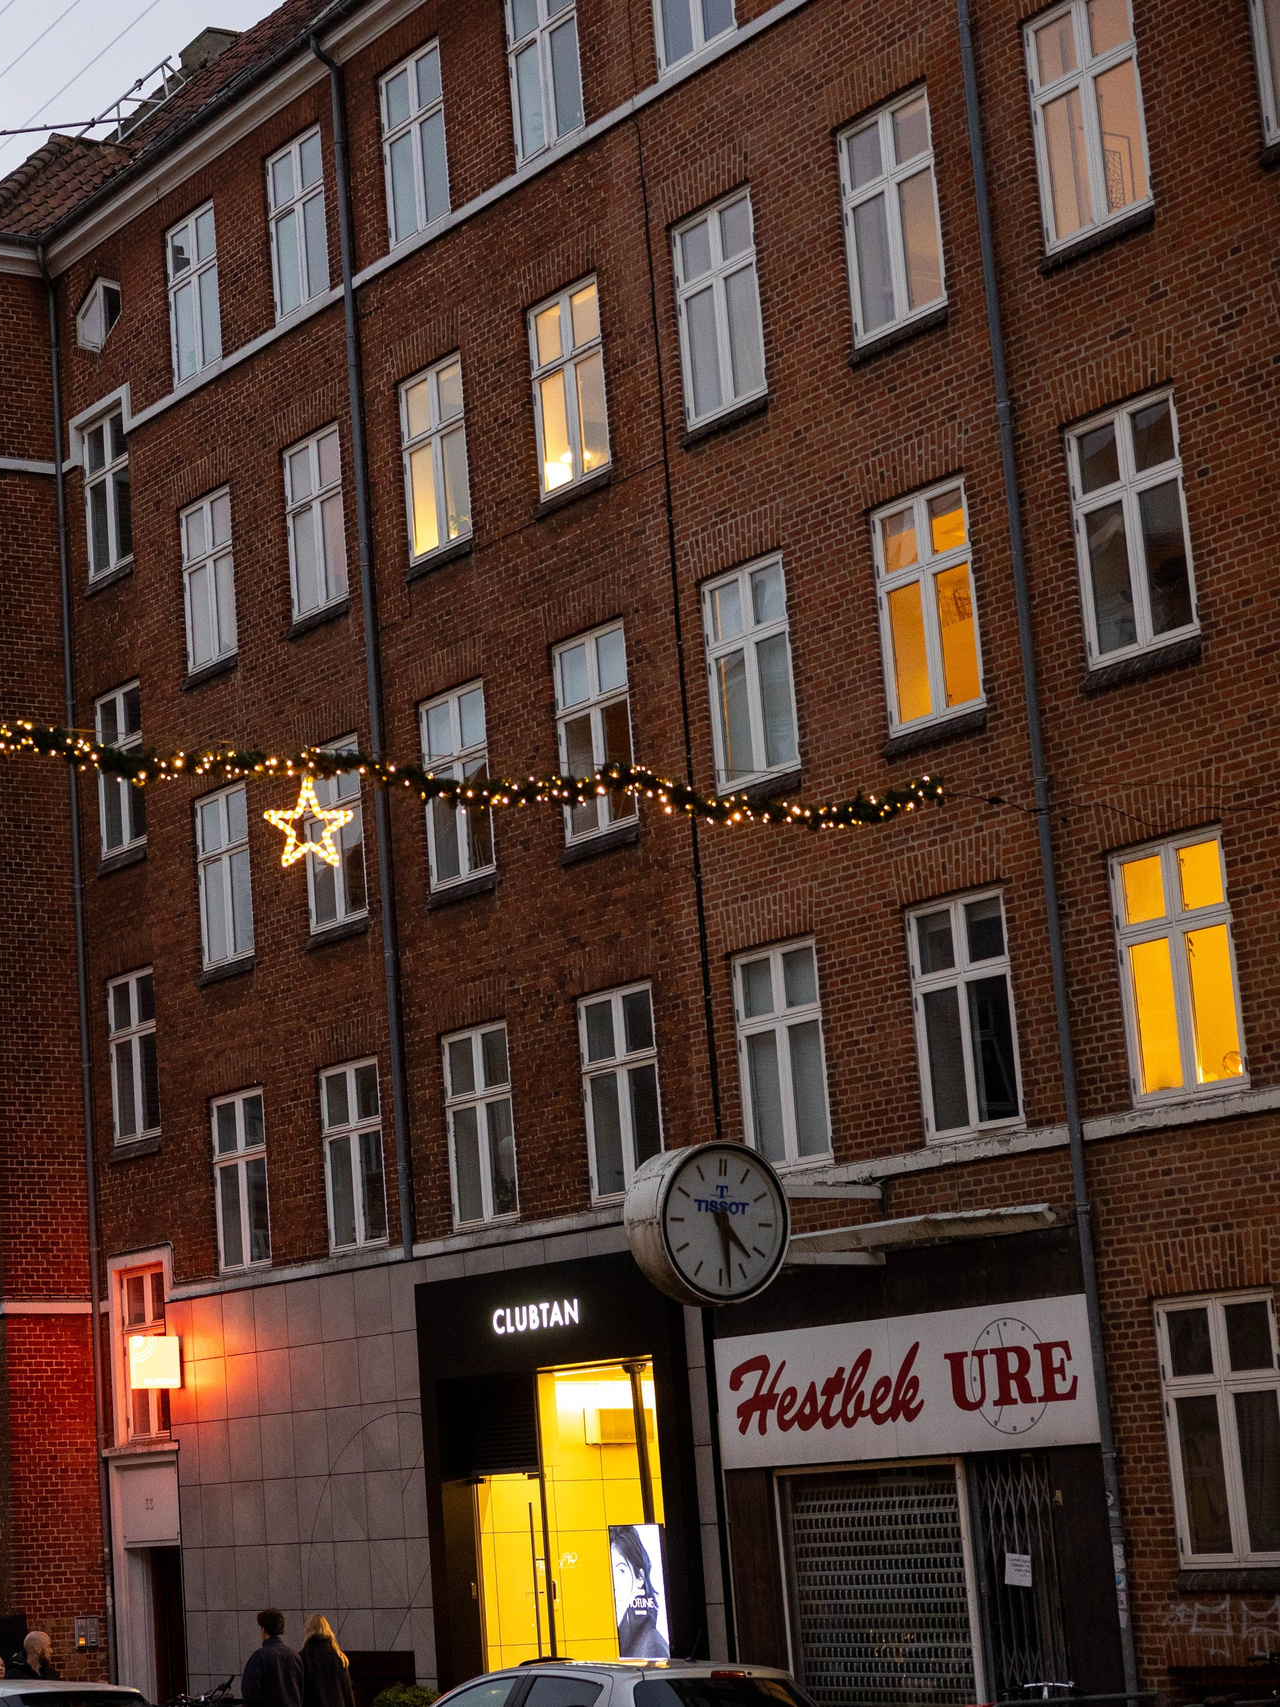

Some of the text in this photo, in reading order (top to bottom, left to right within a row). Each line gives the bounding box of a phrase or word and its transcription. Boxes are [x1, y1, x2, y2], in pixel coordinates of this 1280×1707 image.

[693, 1198, 750, 1215] TISSOT
[492, 1298, 579, 1335] CLUBTAN
[729, 1340, 1079, 1436] Hestbek URE
